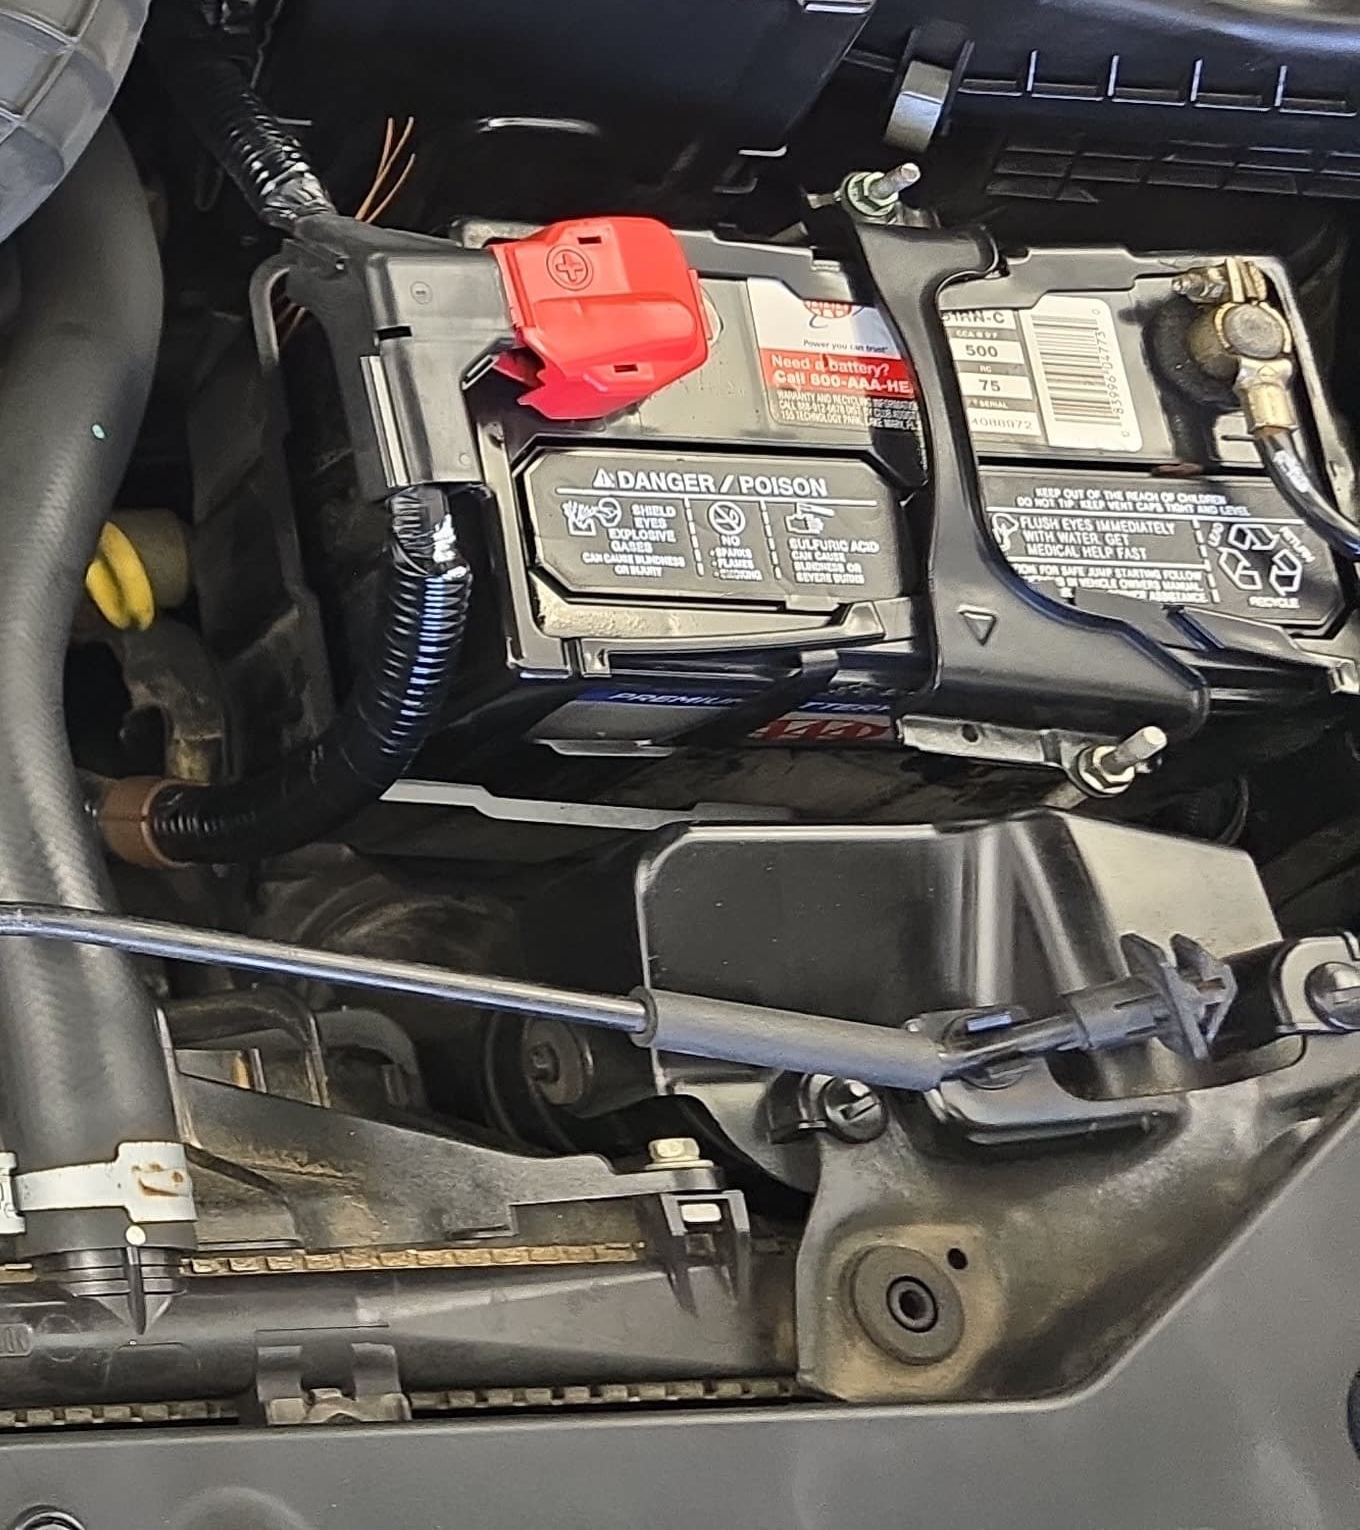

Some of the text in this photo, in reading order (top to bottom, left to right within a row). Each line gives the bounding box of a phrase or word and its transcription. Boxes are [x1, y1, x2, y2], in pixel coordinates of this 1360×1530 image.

[804, 339, 830, 350] Power
[832, 343, 848, 352] you
[965, 344, 998, 358] 500
[771, 354, 890, 377] Need a battery?
[774, 370, 914, 394] Call 800-AAA-HE
[979, 379, 1001, 393] 75
[616, 470, 716, 493] DANGER
[738, 475, 829, 497] POISON
[1034, 487, 1226, 506] KEEP OUT OF THE REACH OF CHILDREN
[631, 504, 676, 518] SHIELD
[1016, 496, 1032, 507] DO
[1033, 497, 1055, 508] NOT
[1079, 499, 1105, 510] KEEP
[1107, 500, 1134, 511] VENT
[1136, 501, 1164, 513] CAPS
[633, 517, 668, 529] EYES
[1019, 516, 1176, 536] FLUSH EYES IMMEDIATELY
[607, 528, 677, 543] EXPLOSIVE
[721, 535, 740, 547] NO
[1024, 530, 1130, 547] WITH GET
[611, 541, 653, 554] GASES
[787, 538, 880, 553] SULFURIC ACID
[1027, 543, 1147, 561] MEDICAL HELP FAST
[582, 552, 686, 567] CAN CAUSE BLINDNESS
[789, 551, 846, 563] CAN CAUSE
[793, 561, 845, 573] BLINDNESS
[1039, 565, 1203, 582] FOR SAFE JUMP STARTING FOLLOW
[795, 571, 833, 584] SEVERE
[1248, 596, 1301, 609] RECYCLE
